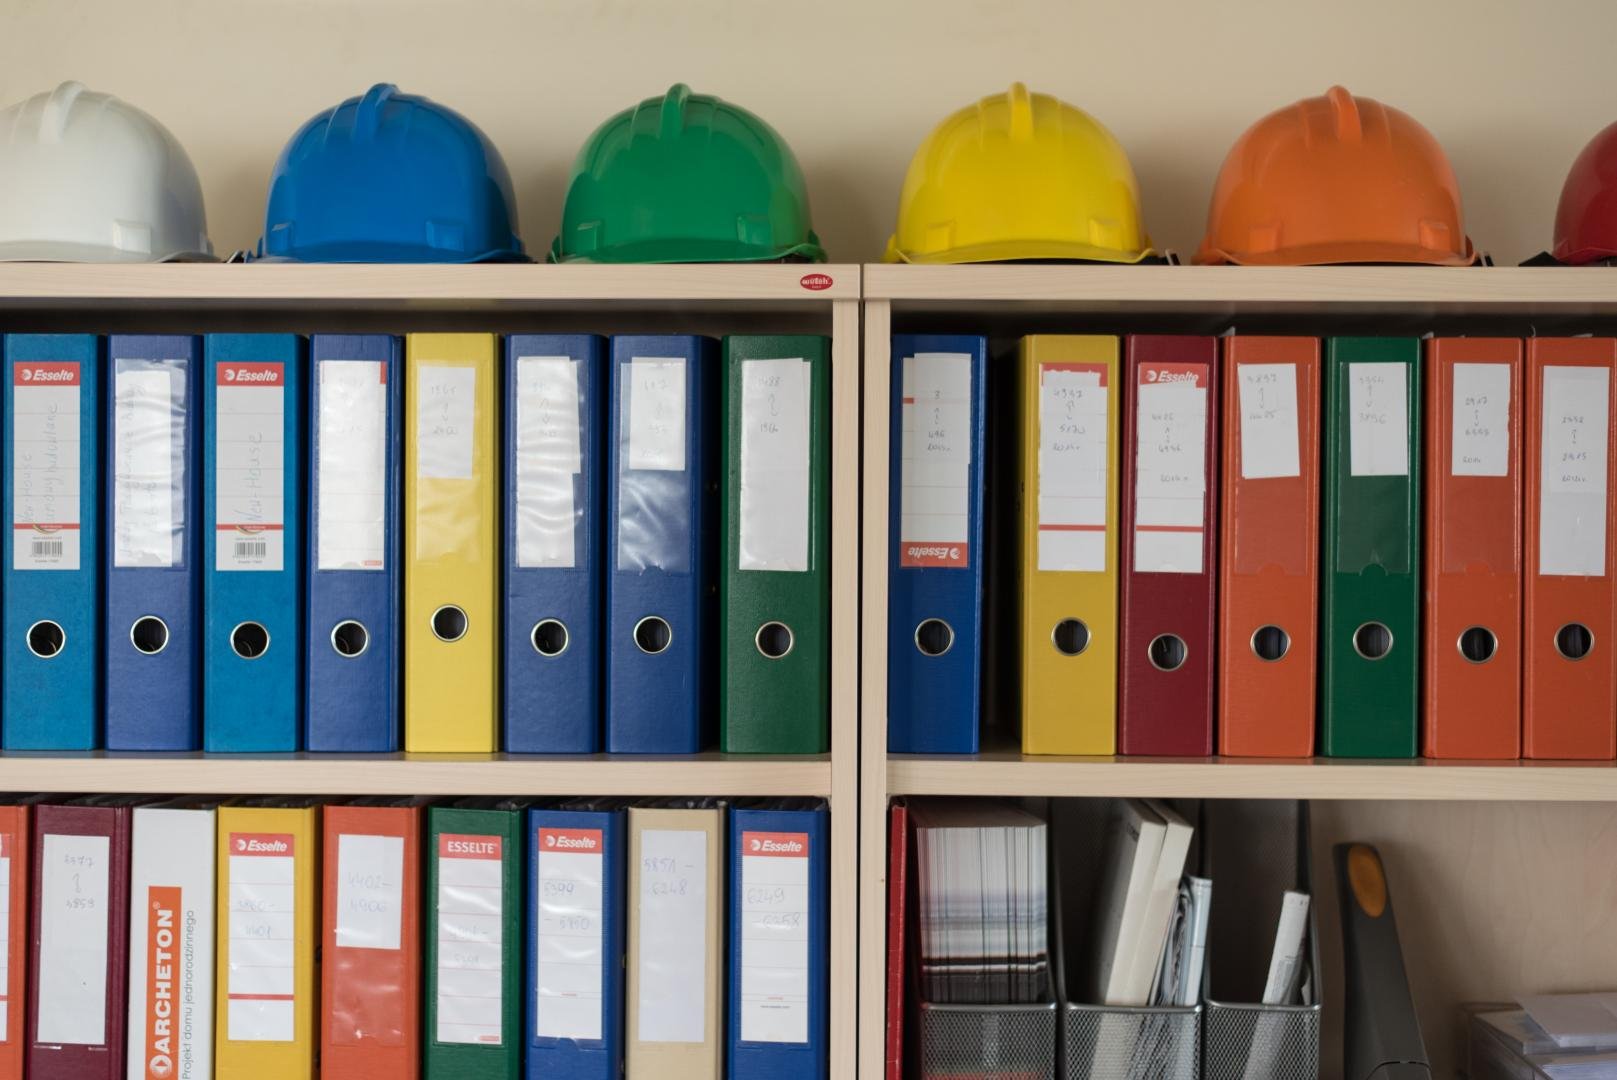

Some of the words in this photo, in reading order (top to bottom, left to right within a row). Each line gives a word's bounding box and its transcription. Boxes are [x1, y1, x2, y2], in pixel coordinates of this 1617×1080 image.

[32, 369, 74, 382] Esselte
[235, 369, 278, 382] Esselte
[1157, 370, 1199, 383] Esselte
[907, 546, 950, 559] Esselte
[246, 839, 287, 852] Esselte
[447, 841, 496, 854] ESSELTE
[556, 836, 597, 848] Esselte
[761, 840, 802, 852] Esselte
[183, 910, 197, 1005] jednorodzinnego
[182, 1006, 193, 1041] domu
[182, 1043, 194, 1080] Projekt
